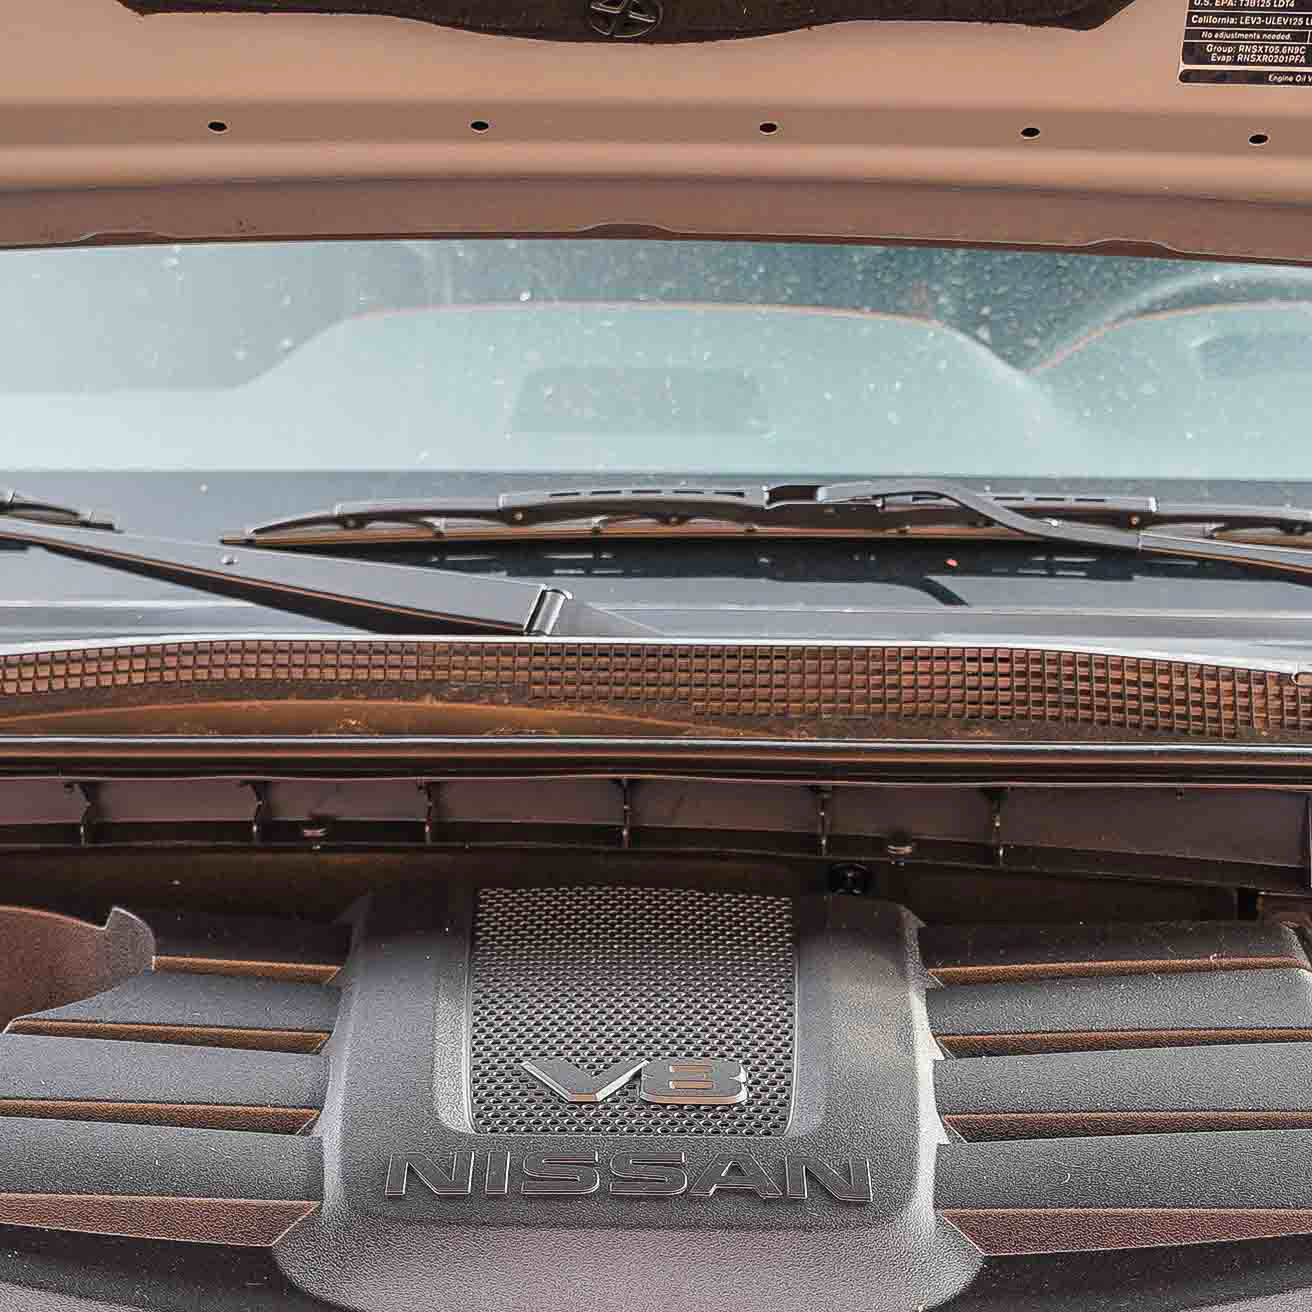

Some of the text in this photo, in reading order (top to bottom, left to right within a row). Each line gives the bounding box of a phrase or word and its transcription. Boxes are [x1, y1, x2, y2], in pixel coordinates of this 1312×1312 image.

[1191, 15, 1238, 24] California:
[1201, 31, 1213, 39] No
[1214, 32, 1261, 41] adjustments
[1206, 44, 1236, 54] Group:
[1268, 73, 1293, 83] Engine
[521, 1057, 749, 1105] V8
[384, 1150, 874, 1202] NISSAN
